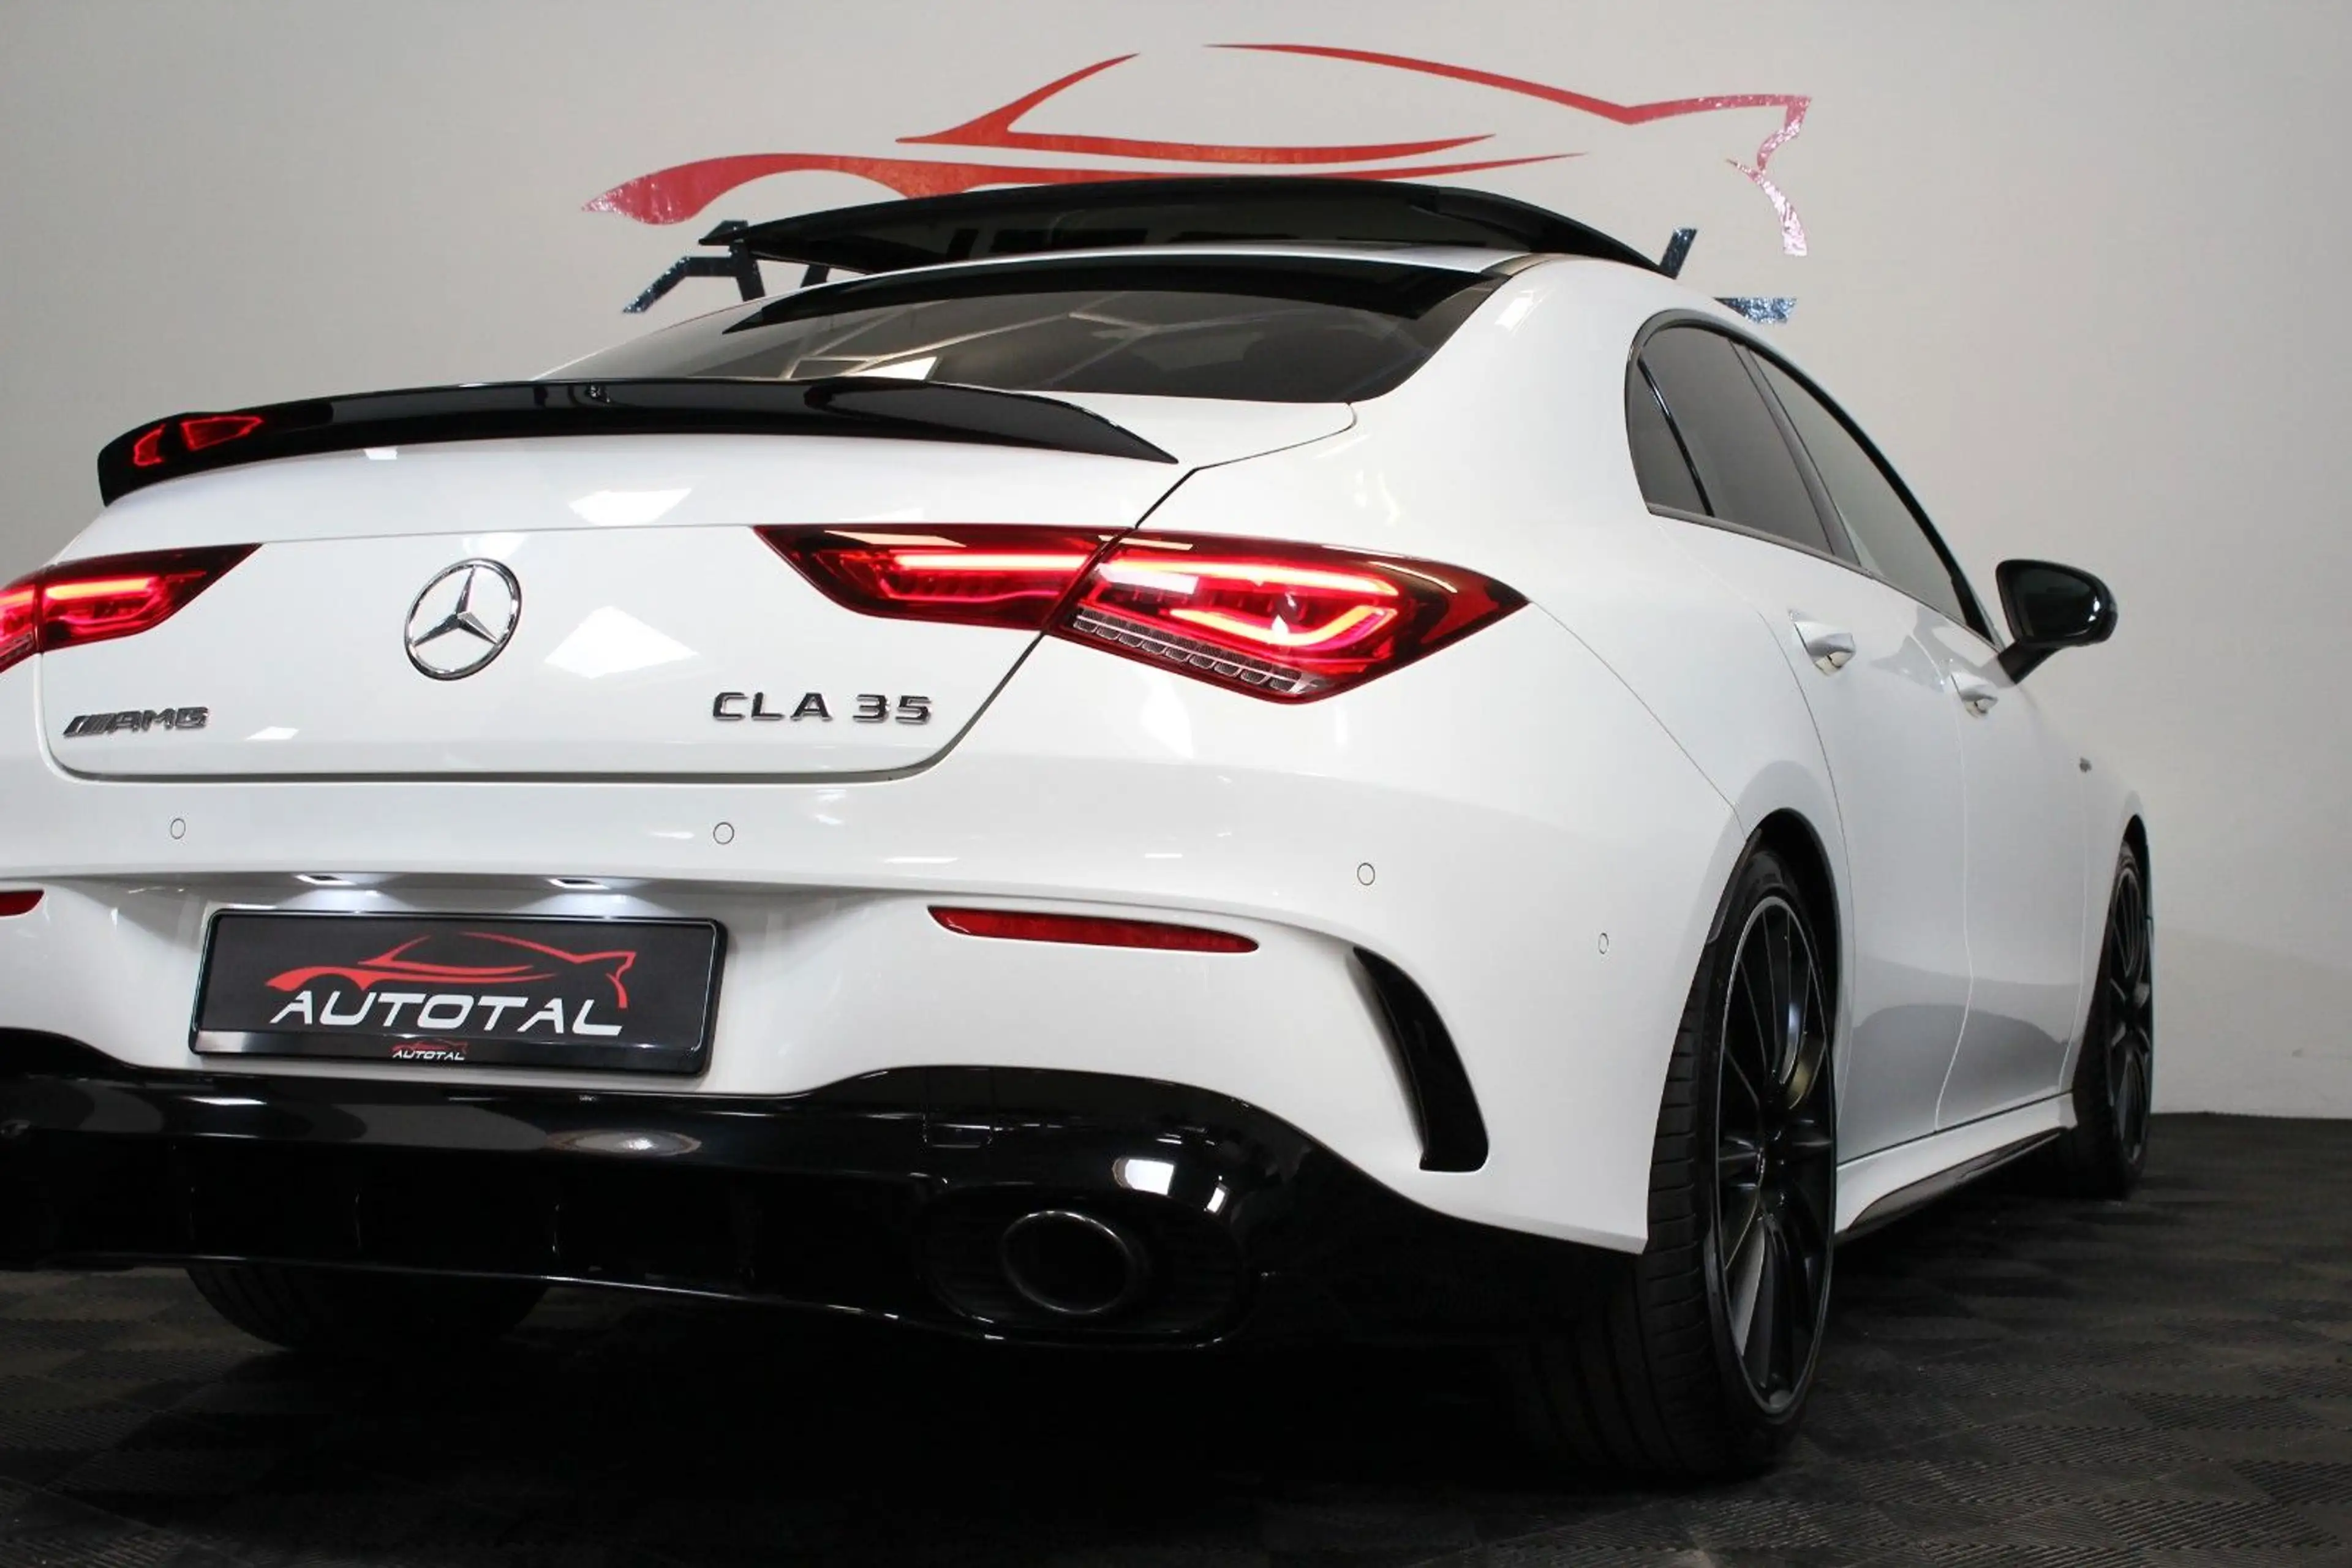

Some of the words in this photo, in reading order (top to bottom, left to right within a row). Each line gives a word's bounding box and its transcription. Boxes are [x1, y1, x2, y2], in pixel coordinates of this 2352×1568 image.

[104, 706, 209, 734] AMG
[712, 692, 832, 722] CLA
[852, 693, 933, 725] 35
[270, 990, 623, 1036] AUTOTAL
[393, 1050, 466, 1060] AUTOTAL
